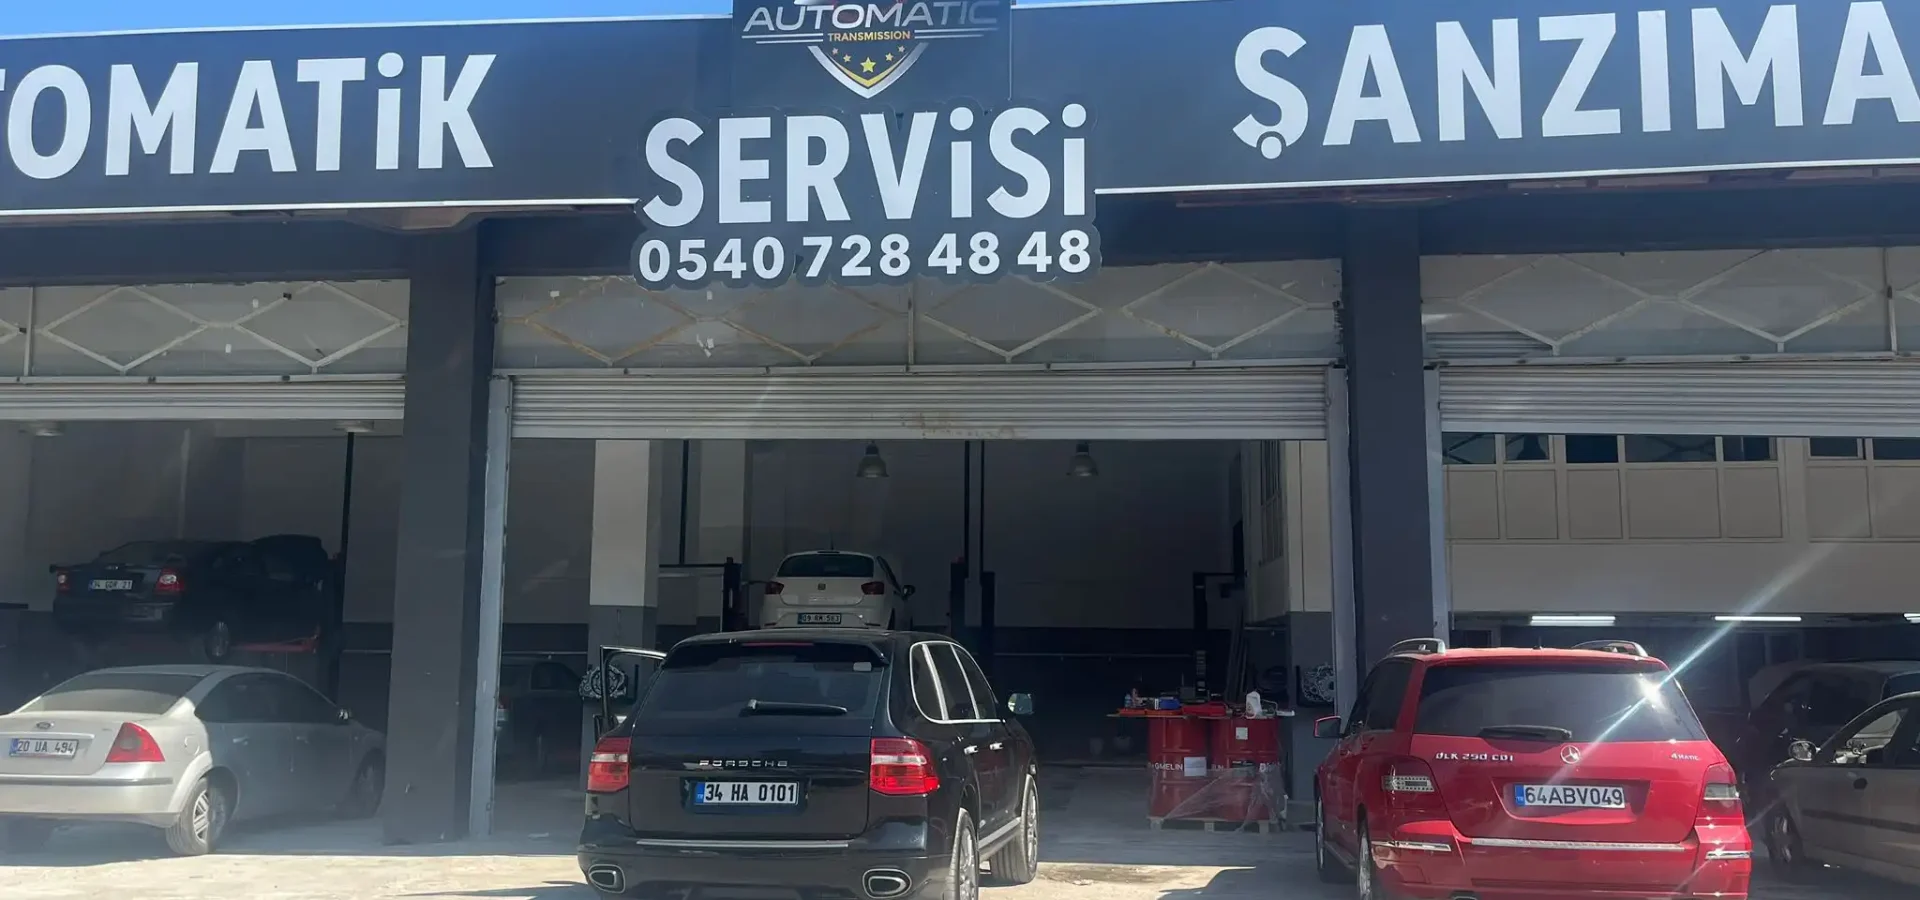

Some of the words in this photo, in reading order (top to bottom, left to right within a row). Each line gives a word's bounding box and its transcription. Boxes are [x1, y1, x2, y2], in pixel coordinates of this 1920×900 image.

[743, 1, 1001, 32] AUTOMATIC
[828, 31, 911, 42] TRANSMISSION
[638, 236, 785, 283] 0540
[802, 233, 911, 278] 728
[928, 231, 1000, 276] 48
[1017, 229, 1091, 273] 48
[17, 740, 30, 752] 20
[35, 741, 48, 753] UA
[54, 742, 74, 754] 494
[705, 784, 723, 801] 34
[731, 784, 749, 801] HA
[758, 784, 795, 802] 0101
[1525, 786, 1623, 806] 64ABV049
